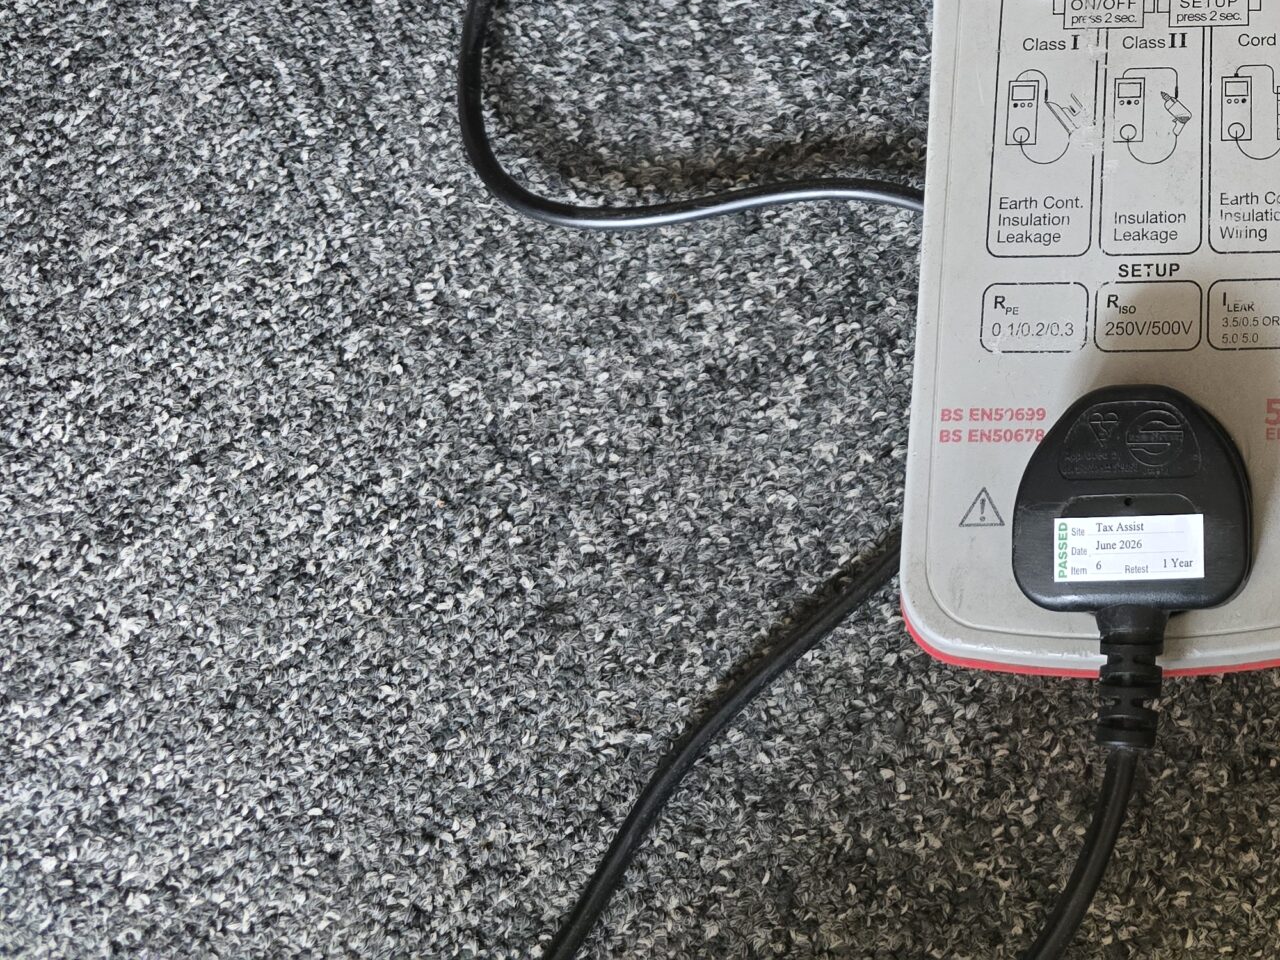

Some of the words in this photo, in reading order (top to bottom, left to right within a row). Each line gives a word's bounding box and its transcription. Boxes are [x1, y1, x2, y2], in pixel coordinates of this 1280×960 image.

[1104, 13, 1112, 23] 2
[1114, 14, 1137, 23] sec.
[1177, 13, 1208, 24] press
[1210, 11, 1218, 21] 2
[1219, 12, 1242, 22] sec.
[1023, 38, 1067, 51] Class
[1071, 35, 1080, 50] I
[1122, 36, 1166, 49] Class
[1169, 33, 1188, 48] II
[1238, 33, 1277, 47] Cord
[1000, 197, 1038, 210] Earth
[1043, 196, 1083, 209] Cont.
[1220, 192, 1259, 205] Earth
[998, 213, 1070, 226] Insulation
[1114, 211, 1187, 224] Insulation
[997, 230, 1061, 246] Leakage
[1113, 228, 1178, 243] Leakage
[1220, 226, 1268, 241] Wiring
[1118, 263, 1180, 277] SETUP
[1262, 316, 1280, 326] OR
[1105, 320, 1193, 337] 250V/500V
[940, 408, 963, 421] BS
[969, 407, 1046, 421] EN50699
[939, 429, 962, 442] BS
[967, 428, 1045, 442] EN50678
[1071, 527, 1085, 536] Site
[1096, 523, 1113, 532] Tax
[1116, 522, 1144, 532] Assist
[1058, 522, 1068, 578] PASSED
[1071, 547, 1087, 555] Date
[1095, 540, 1117, 550] June
[1119, 539, 1142, 549] 2026
[1071, 567, 1087, 575] Item
[1096, 560, 1102, 570] 6
[1124, 565, 1149, 573] Retest
[1163, 559, 1167, 568] 1
[1171, 558, 1193, 568] Year
